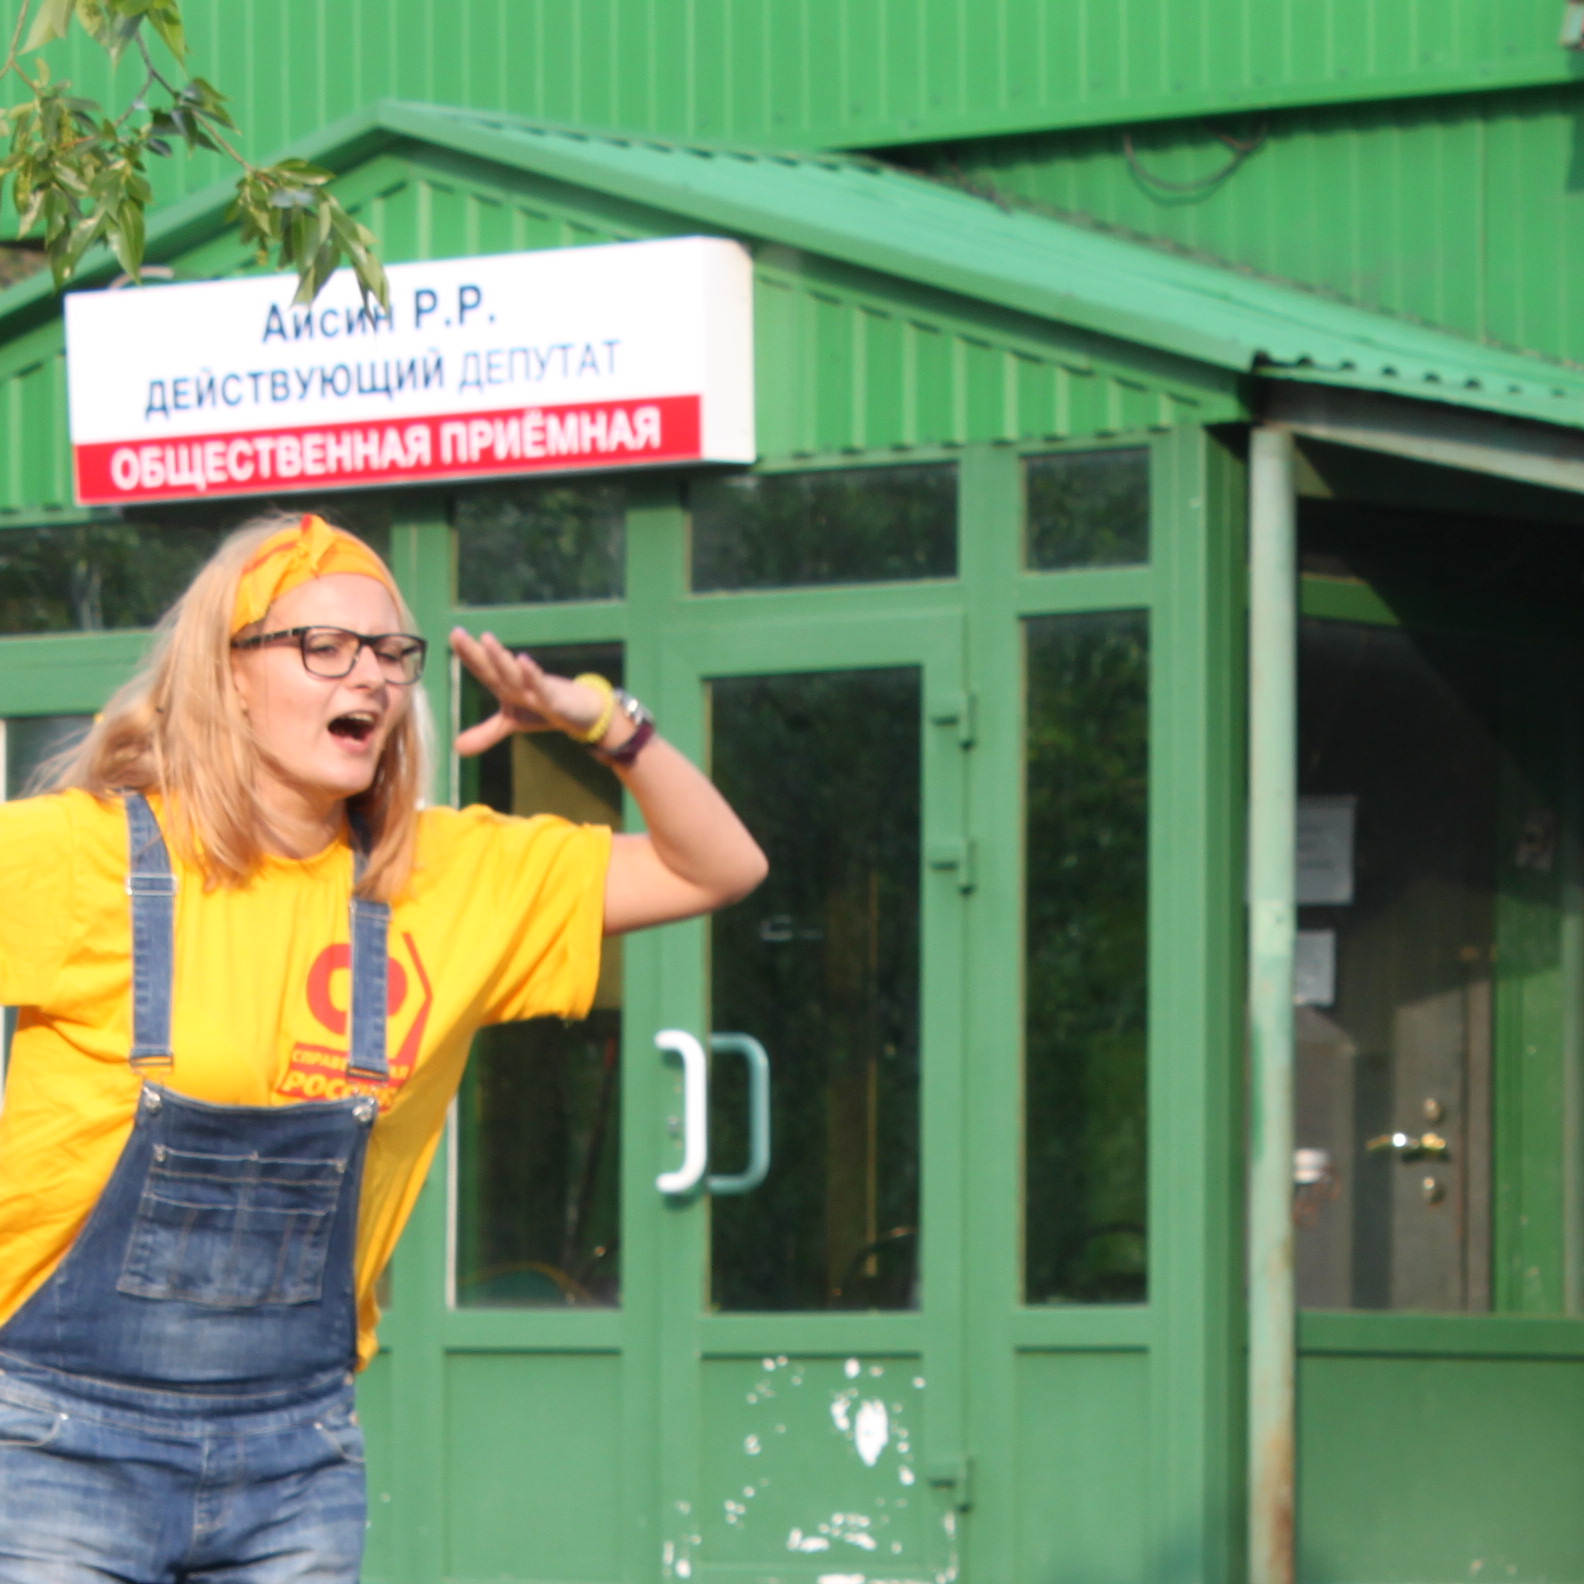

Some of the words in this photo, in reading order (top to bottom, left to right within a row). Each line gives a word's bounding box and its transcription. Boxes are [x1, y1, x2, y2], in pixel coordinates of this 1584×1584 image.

[414, 283, 496, 329] Р.Р.
[145, 347, 444, 420] ДЕЙСТВУЮЩИЙ
[458, 339, 622, 393] ДЕПУТАТ
[111, 423, 432, 491] ОБЩЕСТВЕННАЯ
[439, 406, 661, 465] ПРИЁМНАЯ
